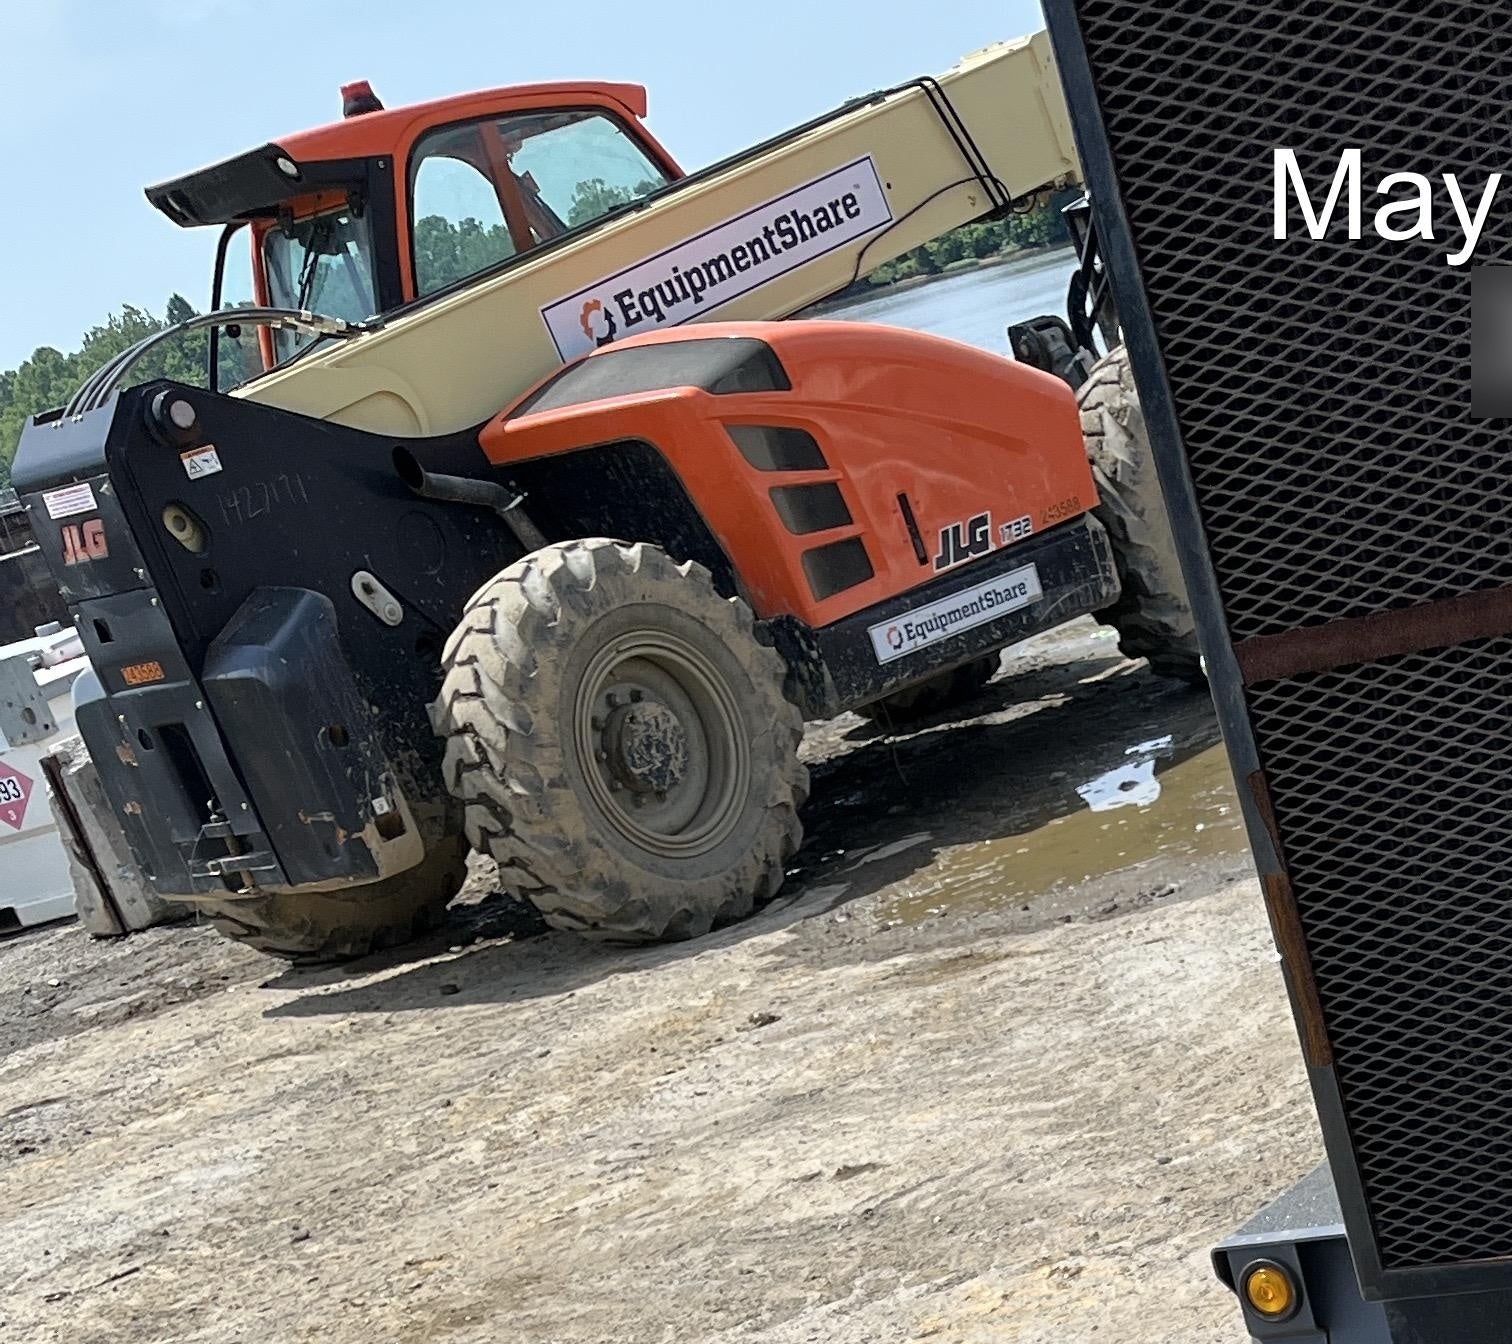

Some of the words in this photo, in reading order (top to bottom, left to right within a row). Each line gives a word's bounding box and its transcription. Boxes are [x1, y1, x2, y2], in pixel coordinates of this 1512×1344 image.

[614, 191, 861, 328] EquipmentShare
[61, 519, 109, 567] JLG
[934, 511, 990, 571] JLG
[903, 581, 1028, 642] EquipmentShare
[0, 778, 21, 803] 93
